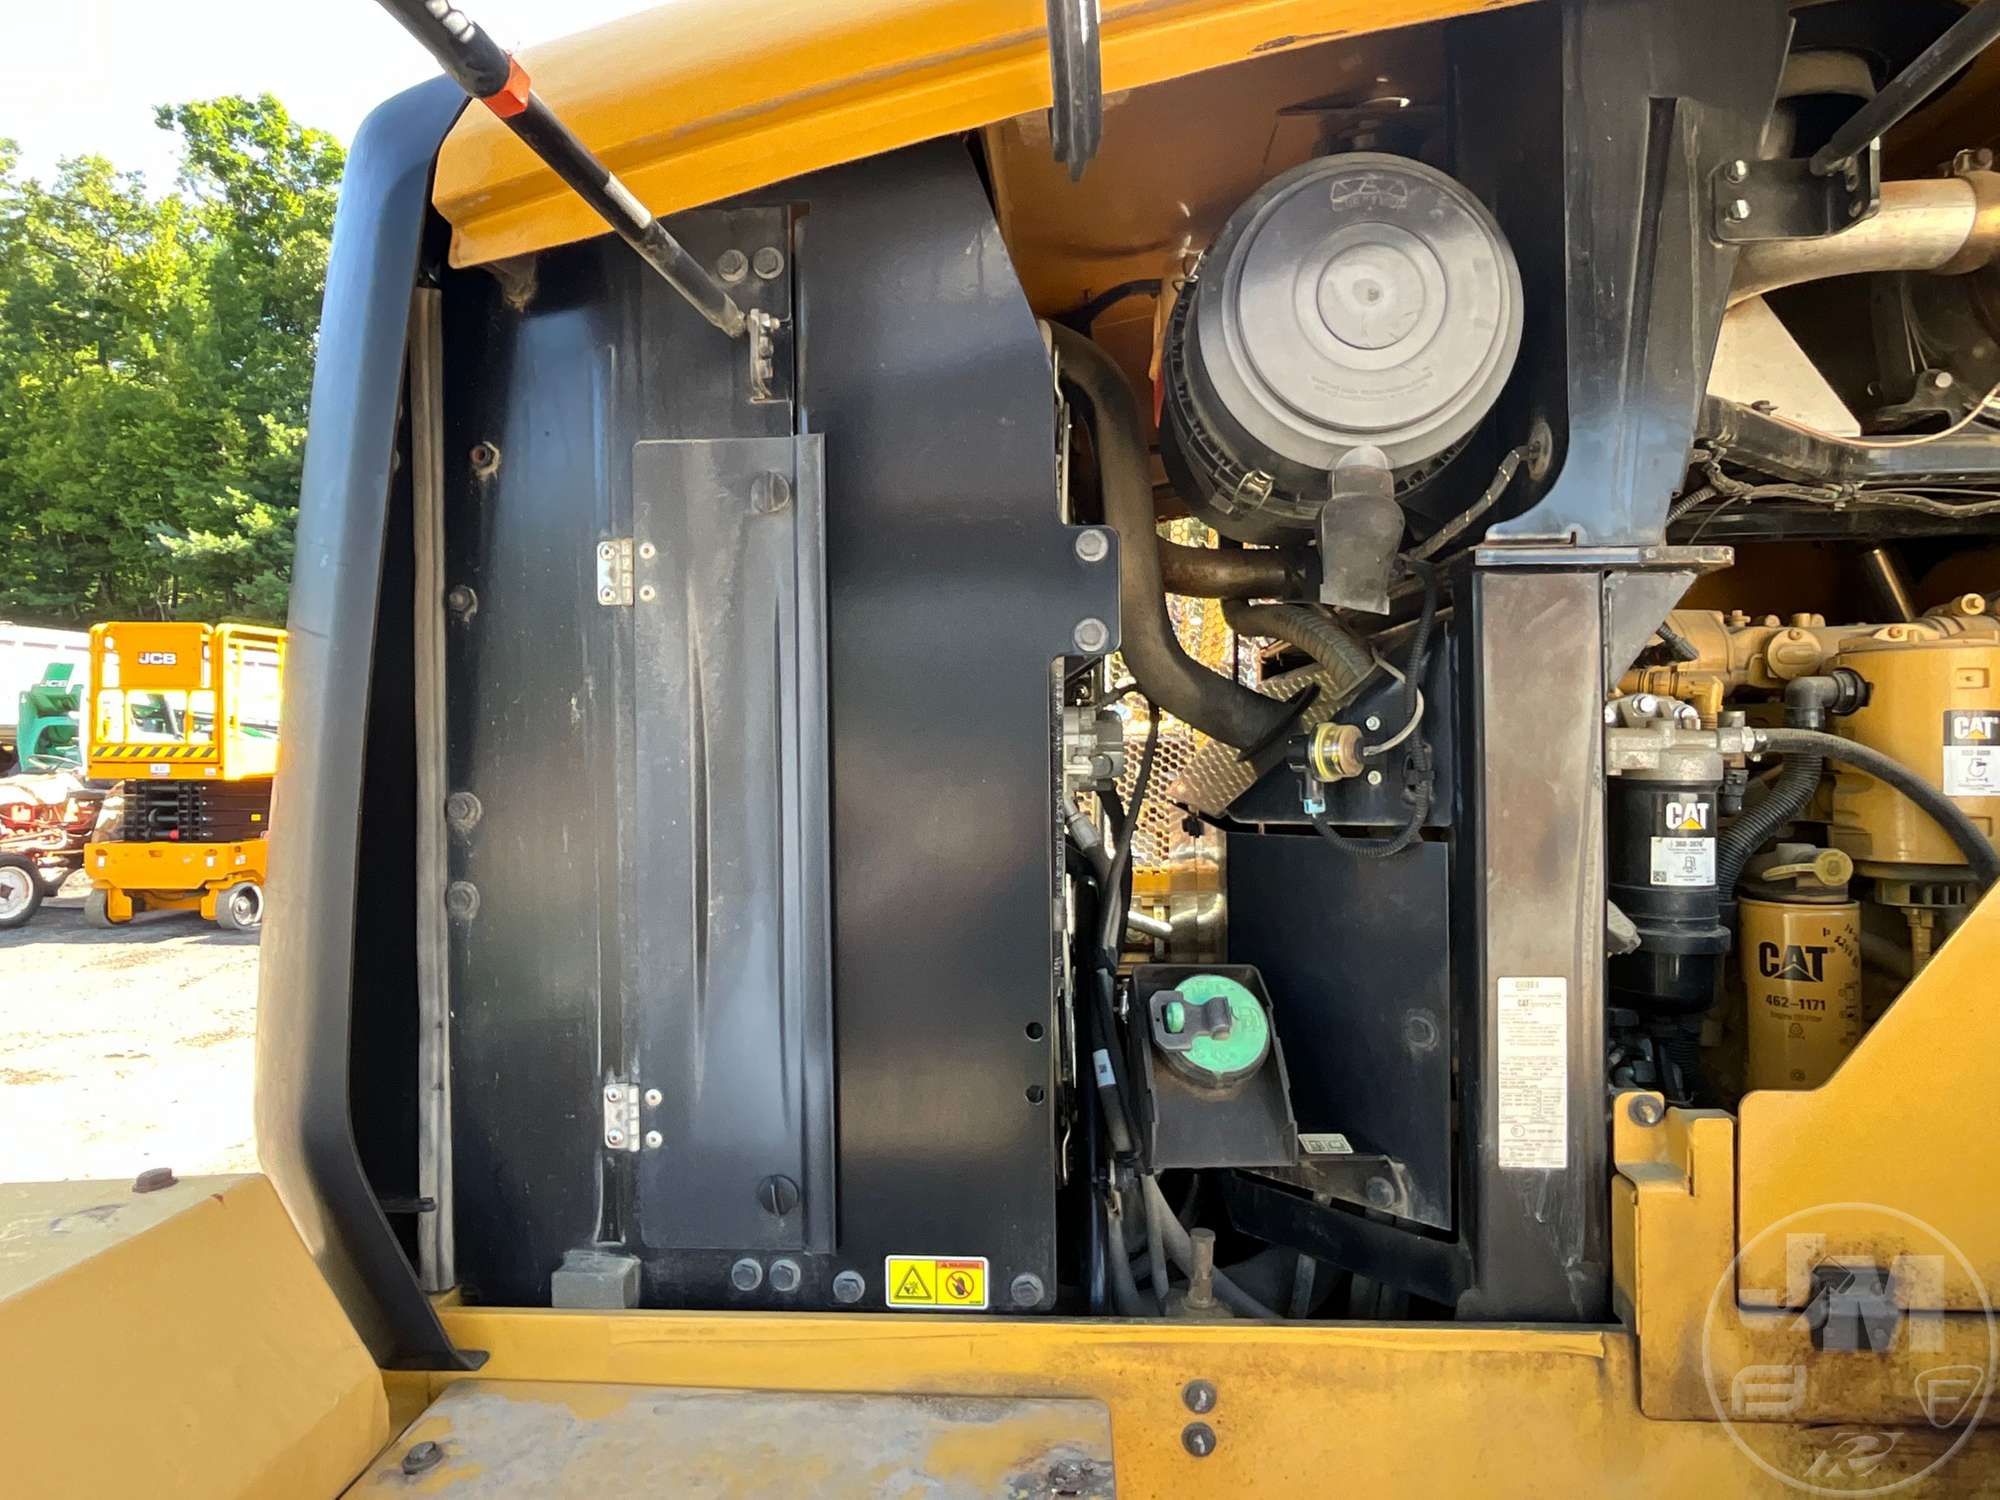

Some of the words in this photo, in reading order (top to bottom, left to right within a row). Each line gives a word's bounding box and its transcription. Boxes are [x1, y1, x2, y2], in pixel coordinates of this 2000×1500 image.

[138, 652, 177, 665] JCB
[1954, 716, 1992, 740] CAT
[1665, 802, 1710, 830] CAT
[1759, 941, 1828, 983] CAT
[1766, 994, 1826, 1011] 462-1171
